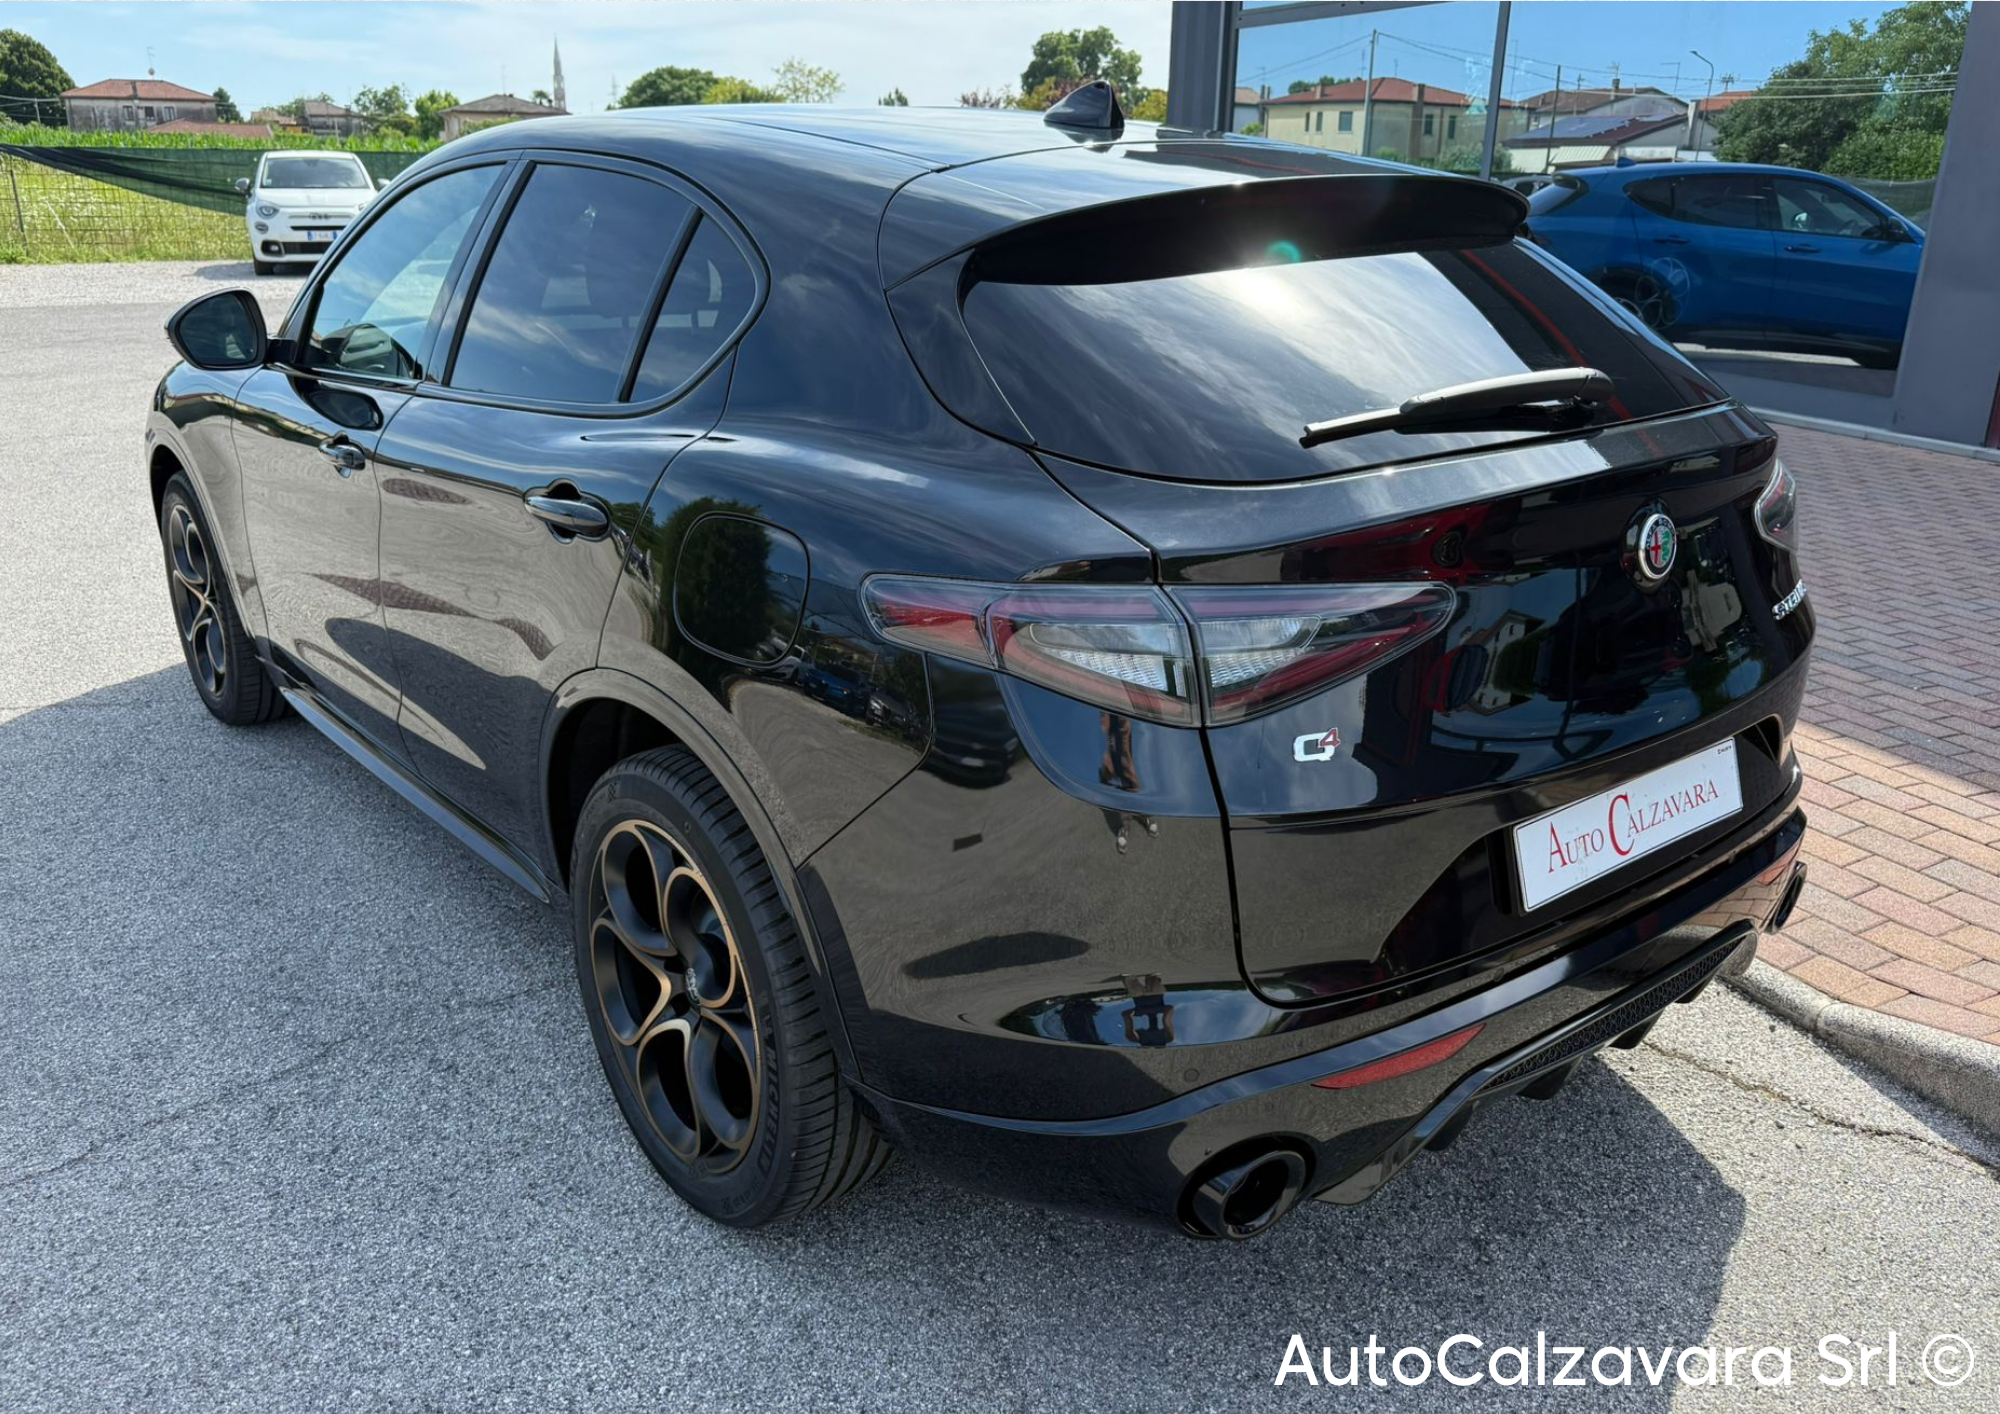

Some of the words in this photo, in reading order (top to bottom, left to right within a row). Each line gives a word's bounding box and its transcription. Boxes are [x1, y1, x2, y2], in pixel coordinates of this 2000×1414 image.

[1293, 727, 1341, 762] Q4
[1547, 821, 1605, 874] AUTO
[1607, 779, 1719, 857] CALZAVARA
[760, 1047, 779, 1171] MICHELIN
